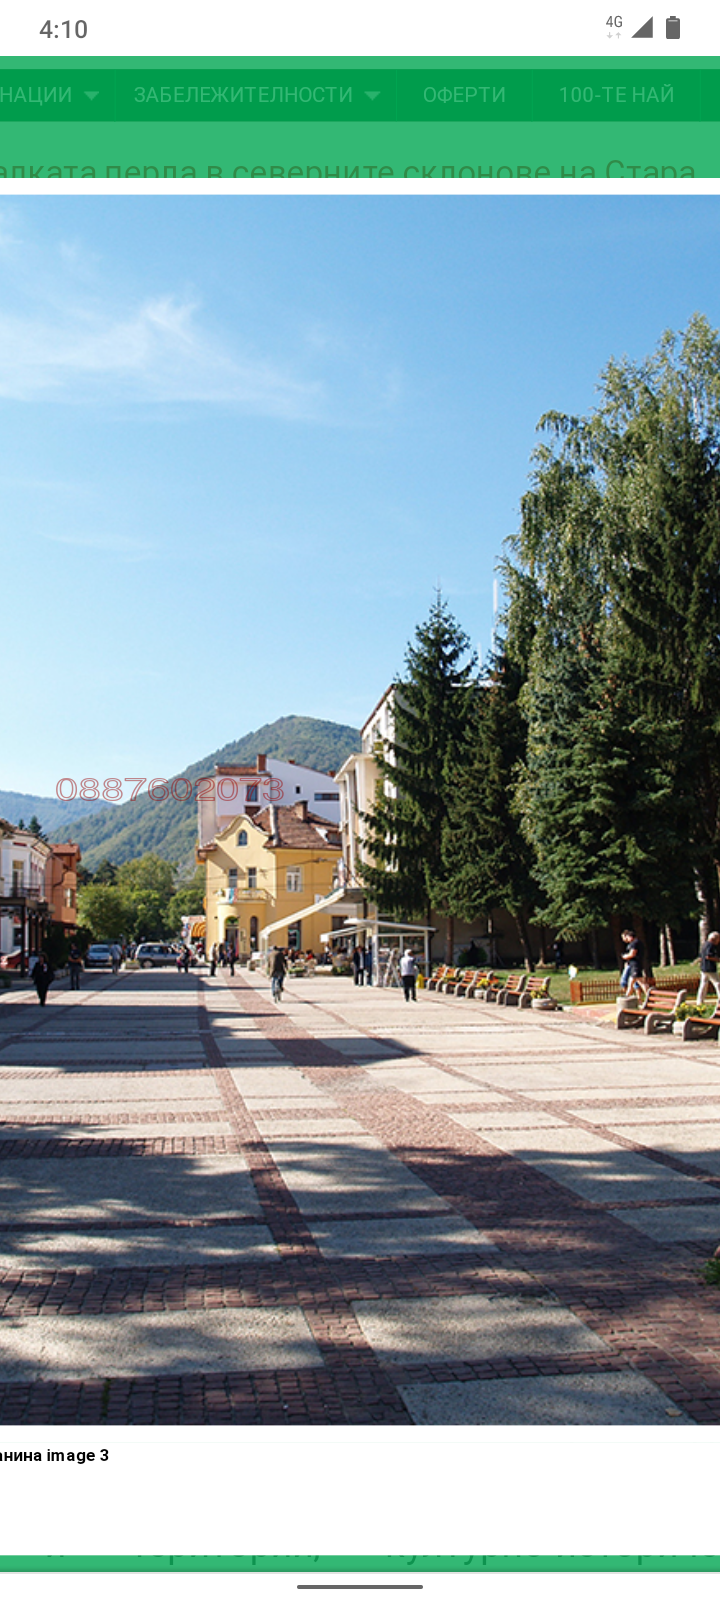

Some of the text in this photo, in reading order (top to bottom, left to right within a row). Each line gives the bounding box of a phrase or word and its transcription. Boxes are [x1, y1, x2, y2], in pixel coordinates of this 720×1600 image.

[39, 19, 88, 39] 4:10
[606, 15, 623, 28] 4G
[0, 86, 72, 106] НАЦИИ
[134, 86, 353, 103] ЗАБЕЛЕЖИТЕЛНОСТИ
[423, 86, 506, 103] ОФЕРТИ
[559, 84, 674, 103] 100-ТЕ НАЙ
[560, 165, 596, 178] на
[0, 1448, 109, 1465] нина image 3
